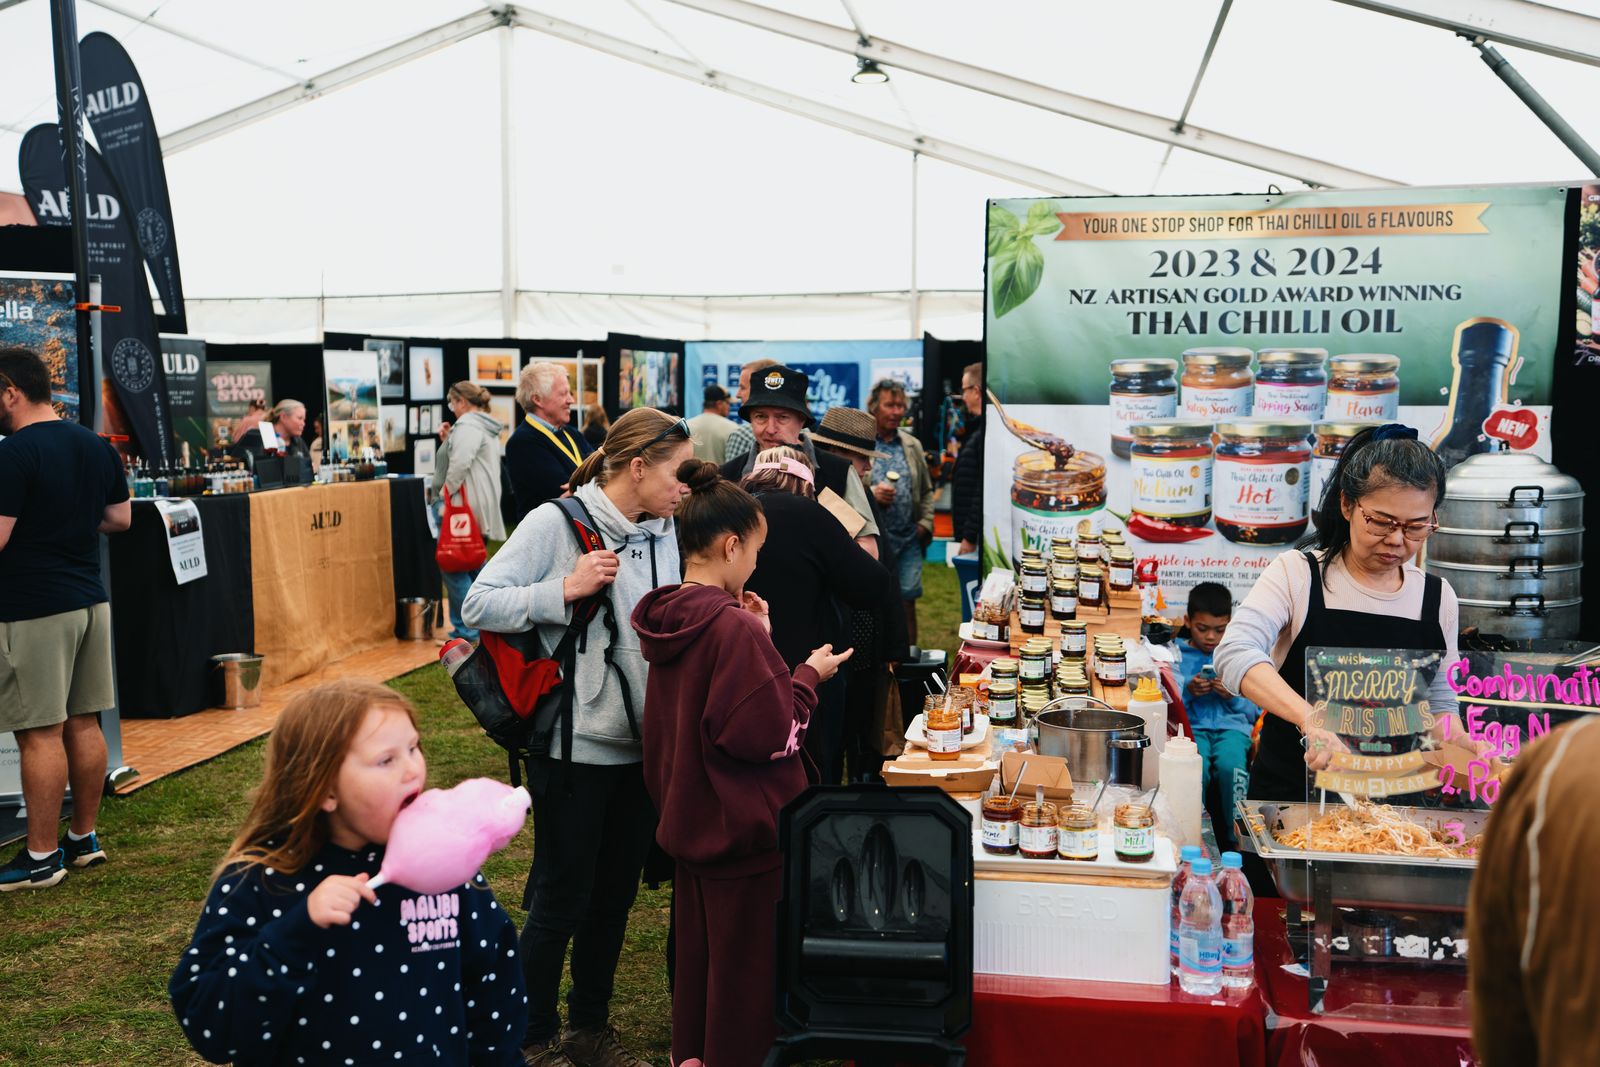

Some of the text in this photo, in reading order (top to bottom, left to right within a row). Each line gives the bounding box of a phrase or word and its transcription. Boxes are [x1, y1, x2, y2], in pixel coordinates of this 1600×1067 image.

[85, 82, 140, 117] AULD
[1083, 210, 1454, 234] YOUR ONE STOP SHOP FOR THAI CHILLI OIL & FLAVOURS
[1148, 246, 1383, 278] 2023 & 2024
[1069, 284, 1463, 305] NZ ARTISAN GOLD AWARD WINNING
[1126, 308, 1404, 335] THAI CHILLI OIL
[162, 353, 200, 375] ULD
[1211, 402, 1238, 414] Sauce
[1294, 400, 1318, 412] Sauce
[1346, 400, 1383, 416] Flava
[1496, 418, 1530, 438] NEW
[1133, 478, 1194, 498] Medium
[1236, 484, 1273, 504] Hot
[1182, 556, 1229, 568] in-store
[1238, 571, 1249, 580] THE
[1338, 653, 1366, 665] wish
[1394, 656, 1402, 665] a
[1324, 669, 1417, 705] MERRY
[1446, 657, 1600, 705] Combinati
[1311, 700, 1436, 738] CHRISTMAS
[1467, 704, 1521, 760] Egg
[1528, 713, 1551, 746] N
[1352, 758, 1404, 771] HAPPY
[1331, 775, 1426, 795] NEW YEAR
[1439, 764, 1462, 796] 2.
[1124, 836, 1146, 846] Mild
[401, 893, 459, 921] MALIBU
[1016, 893, 1120, 921] BREAD
[407, 917, 458, 944] SPORTS
